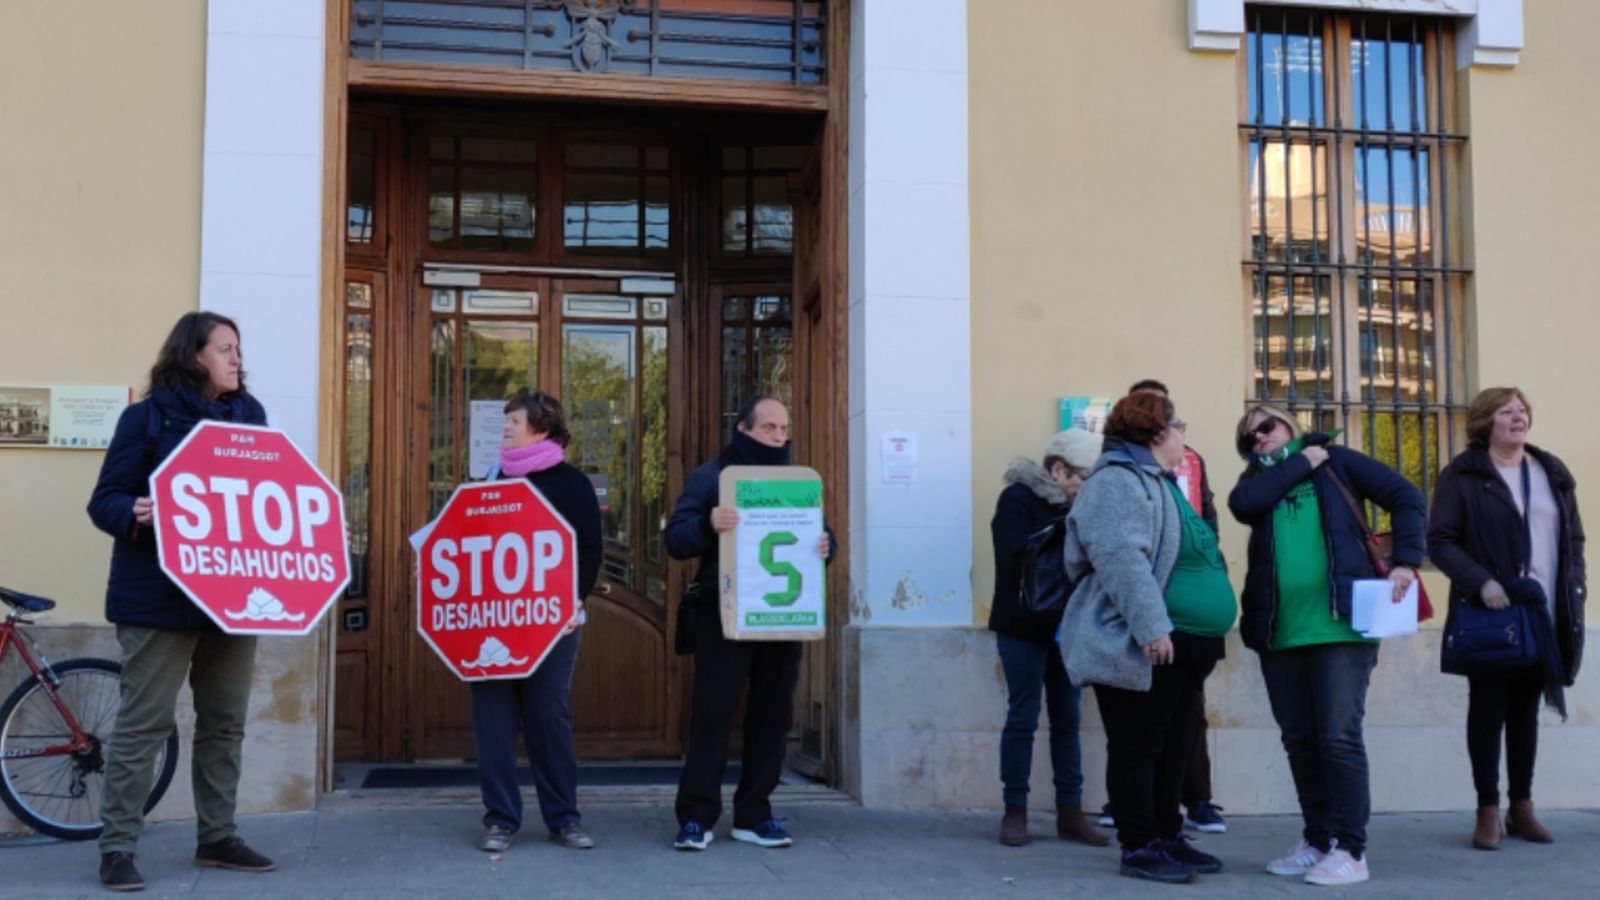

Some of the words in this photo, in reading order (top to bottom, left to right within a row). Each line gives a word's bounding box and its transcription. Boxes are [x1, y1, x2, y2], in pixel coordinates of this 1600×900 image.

[214, 447, 280, 462] BURJASSOT
[170, 472, 330, 548] STOP
[465, 502, 523, 517] BURJASSOT
[178, 544, 336, 582] DESAHUCIOS
[431, 530, 564, 600] STOP
[432, 595, 561, 632] DESAHUCIOS
